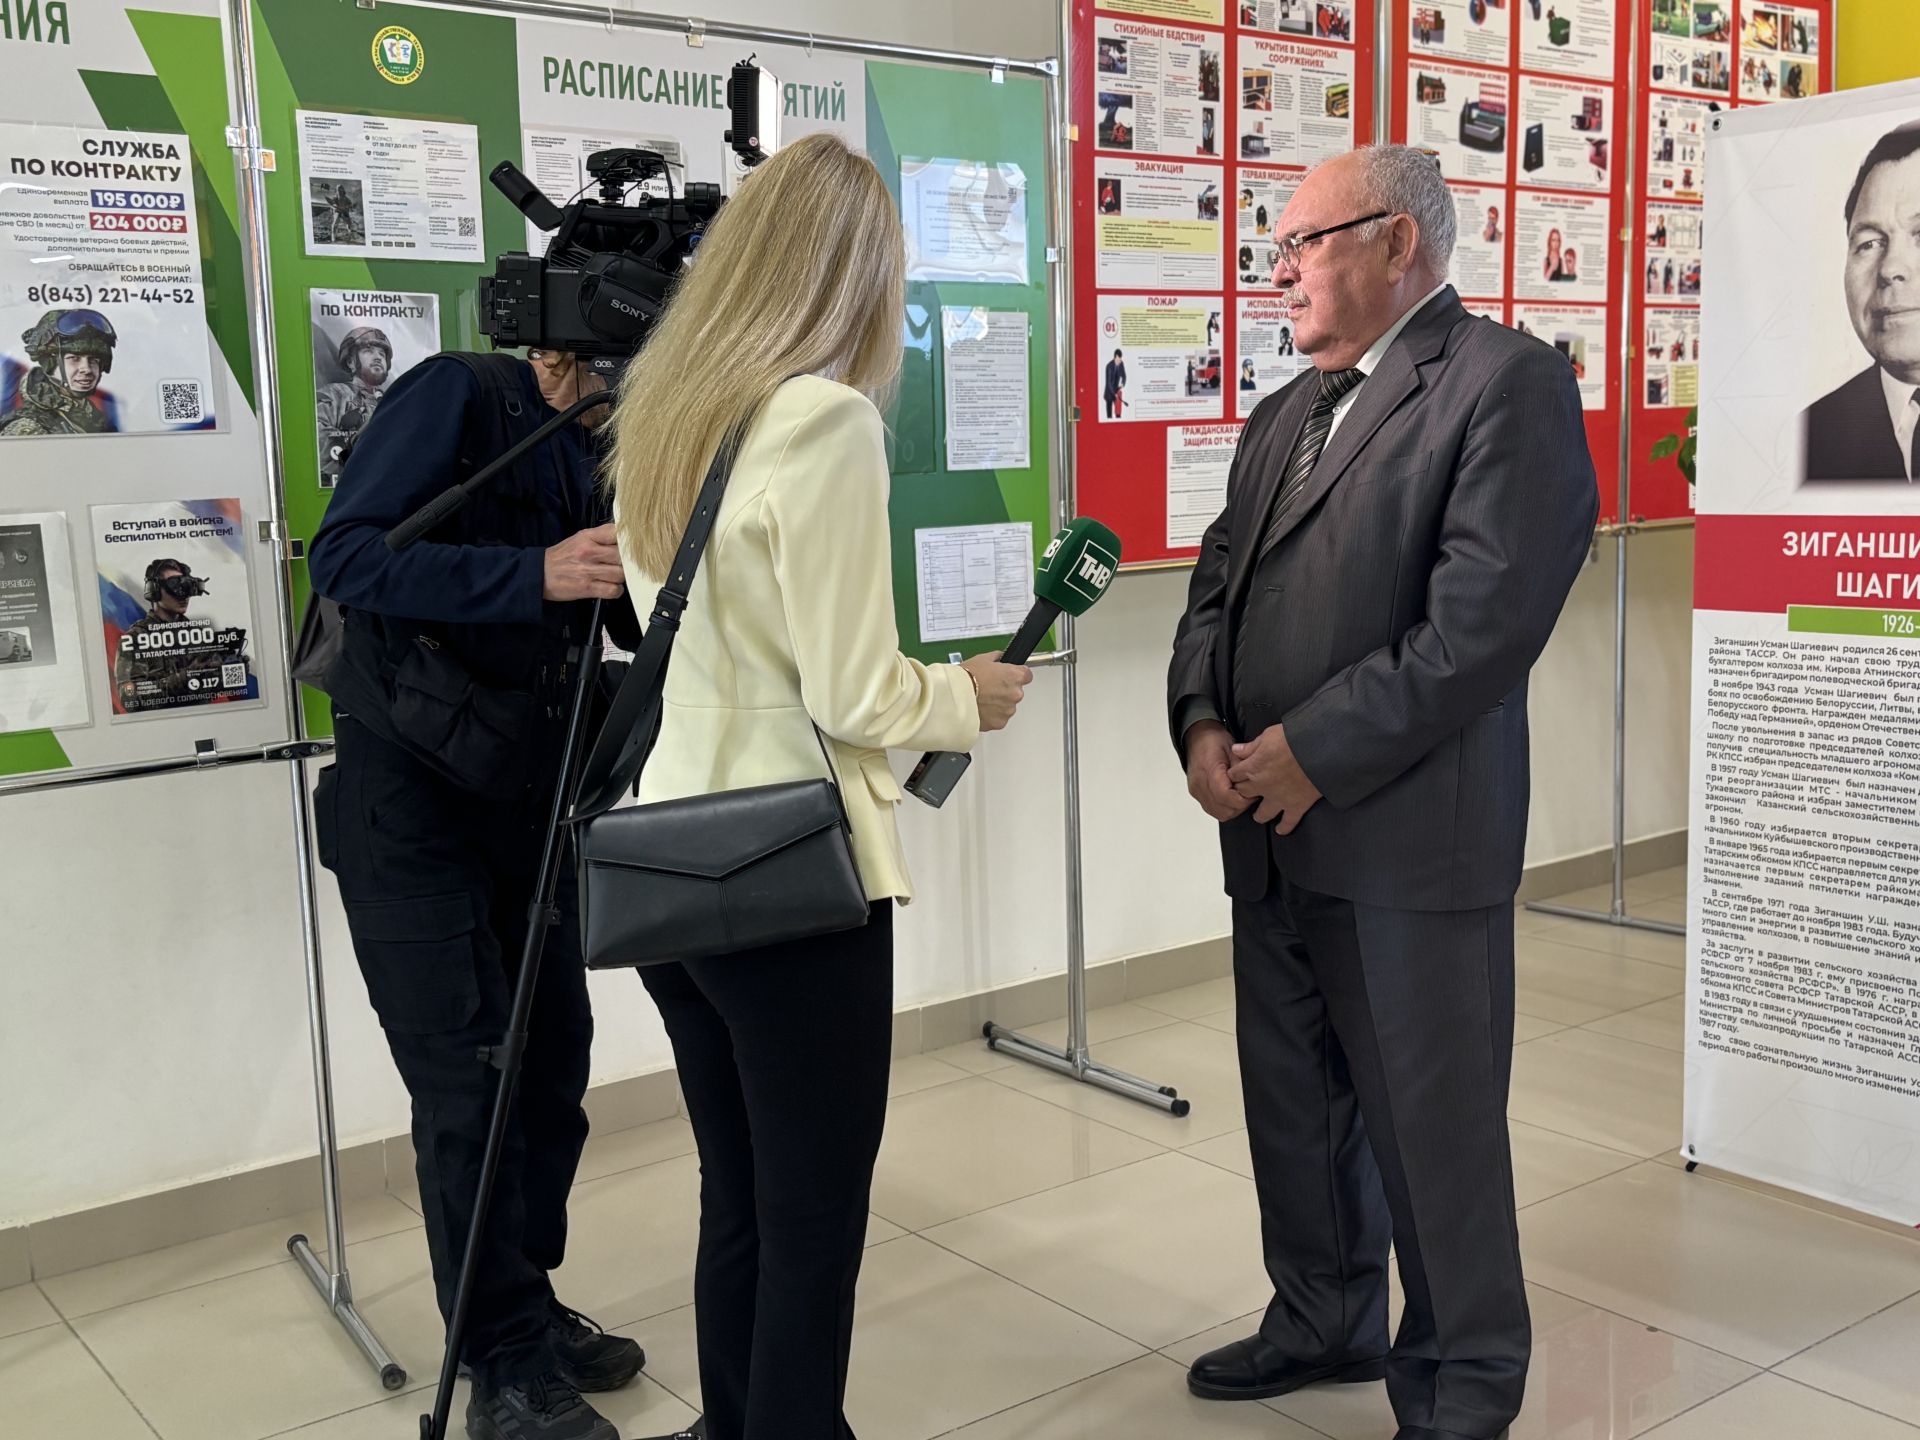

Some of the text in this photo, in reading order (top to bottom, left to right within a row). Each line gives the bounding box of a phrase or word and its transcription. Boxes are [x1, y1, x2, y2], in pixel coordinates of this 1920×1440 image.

[1114, 23, 1205, 43] СТИХИЙНЫЕ БЕДСТВИЯ
[1255, 41, 1338, 59] УКРЫТИЕ В ЗАЩИТНЫХ
[1269, 54, 1325, 68] СООРУЖЕНИЯХ
[544, 57, 846, 121] РАСПИСАНИЕ ЯТИЙ
[82, 139, 181, 160] СЛУЖБА
[10, 158, 182, 182] ПО КОНТРАКТУ
[1135, 162, 1184, 174] ЭВАКУАЦИЯ
[1242, 170, 1266, 180] ПЕРВАЯ
[95, 191, 127, 207] 195
[92, 214, 129, 230] 204
[79, 237, 119, 245] ветерана
[68, 262, 138, 272] ОБРАЩАЙТЕСЬ
[147, 264, 191, 273] ВОЕННЫЙ
[120, 275, 192, 283] КОМИССАРИАТ:
[28, 284, 194, 306] 8(843) 221-44-52
[1148, 297, 1178, 307] ПОЖАР
[320, 304, 424, 318] ПО КОНТРАКТУ
[610, 299, 650, 321] SONY
[1105, 323, 1116, 333] 01
[1182, 425, 1234, 435] ГРАЖДАНСКАЯ
[1184, 437, 1233, 447] ЗАЩИТА ОТ ЧС
[112, 518, 165, 531] Вступай
[182, 516, 223, 527] войска
[105, 527, 234, 544] беспилотных систем!
[148, 619, 211, 631] ЕДИНОВРЕМЕННО
[121, 634, 134, 651] 2
[137, 631, 178, 650] 900
[178, 627, 214, 646] 000
[217, 633, 240, 643] руб.
[1714, 636, 1758, 647] Зиганшин
[1760, 639, 1788, 649] Усман
[1790, 641, 1838, 652] Шагиевич
[1842, 645, 1884, 655] родился
[1886, 646, 1897, 655] 26
[142, 649, 186, 659] ТАТАРСТАНЕ
[1709, 646, 1890, 665] района ТАССР. Он рано начал свою
[1708, 656, 1763, 668] бухгалтером
[1766, 661, 1803, 670] колхоза
[1825, 664, 1860, 675] Кирова
[202, 678, 219, 688] 117
[1708, 667, 1884, 687] назначен бригадиром полеводческой
[1713, 679, 1913, 702] В ноябре 1943 года Усман Шагиевич был
[1708, 688, 1914, 714] боях по освобождению Белоруссии, Литвы,
[1708, 698, 1768, 711] Белорусского
[1771, 705, 1808, 715] фронта.
[1811, 707, 1866, 720] Награжден
[1707, 708, 1739, 720] Победу
[1740, 712, 1757, 721] над
[1758, 713, 1816, 727] Германией»,
[1817, 719, 1860, 730] орденом
[1712, 721, 1738, 731] После
[1741, 725, 1795, 737] увольнения
[1808, 731, 1834, 741] запас
[1837, 734, 1848, 742] из
[1852, 736, 1881, 745] рядов
[1706, 741, 1742, 752] получив
[1748, 746, 1818, 760] специальность
[1820, 753, 1870, 765] младшего
[1707, 732, 1734, 742] школу
[1752, 736, 1805, 748] подготовке
[1809, 742, 1884, 756] председателей
[1711, 763, 1915, 794] В 1957 году Усман Шагиевич был назначен
[1767, 951, 1810, 966] развитии
[1814, 960, 1862, 976] сельского
[1867, 970, 1917, 987] хозяйства
[1780, 1058, 1833, 1077] произошло
[1834, 1071, 1864, 1085] много
[1822, 1058, 1851, 1072] жизнь
[1856, 1064, 1906, 1084] Зиганшин
